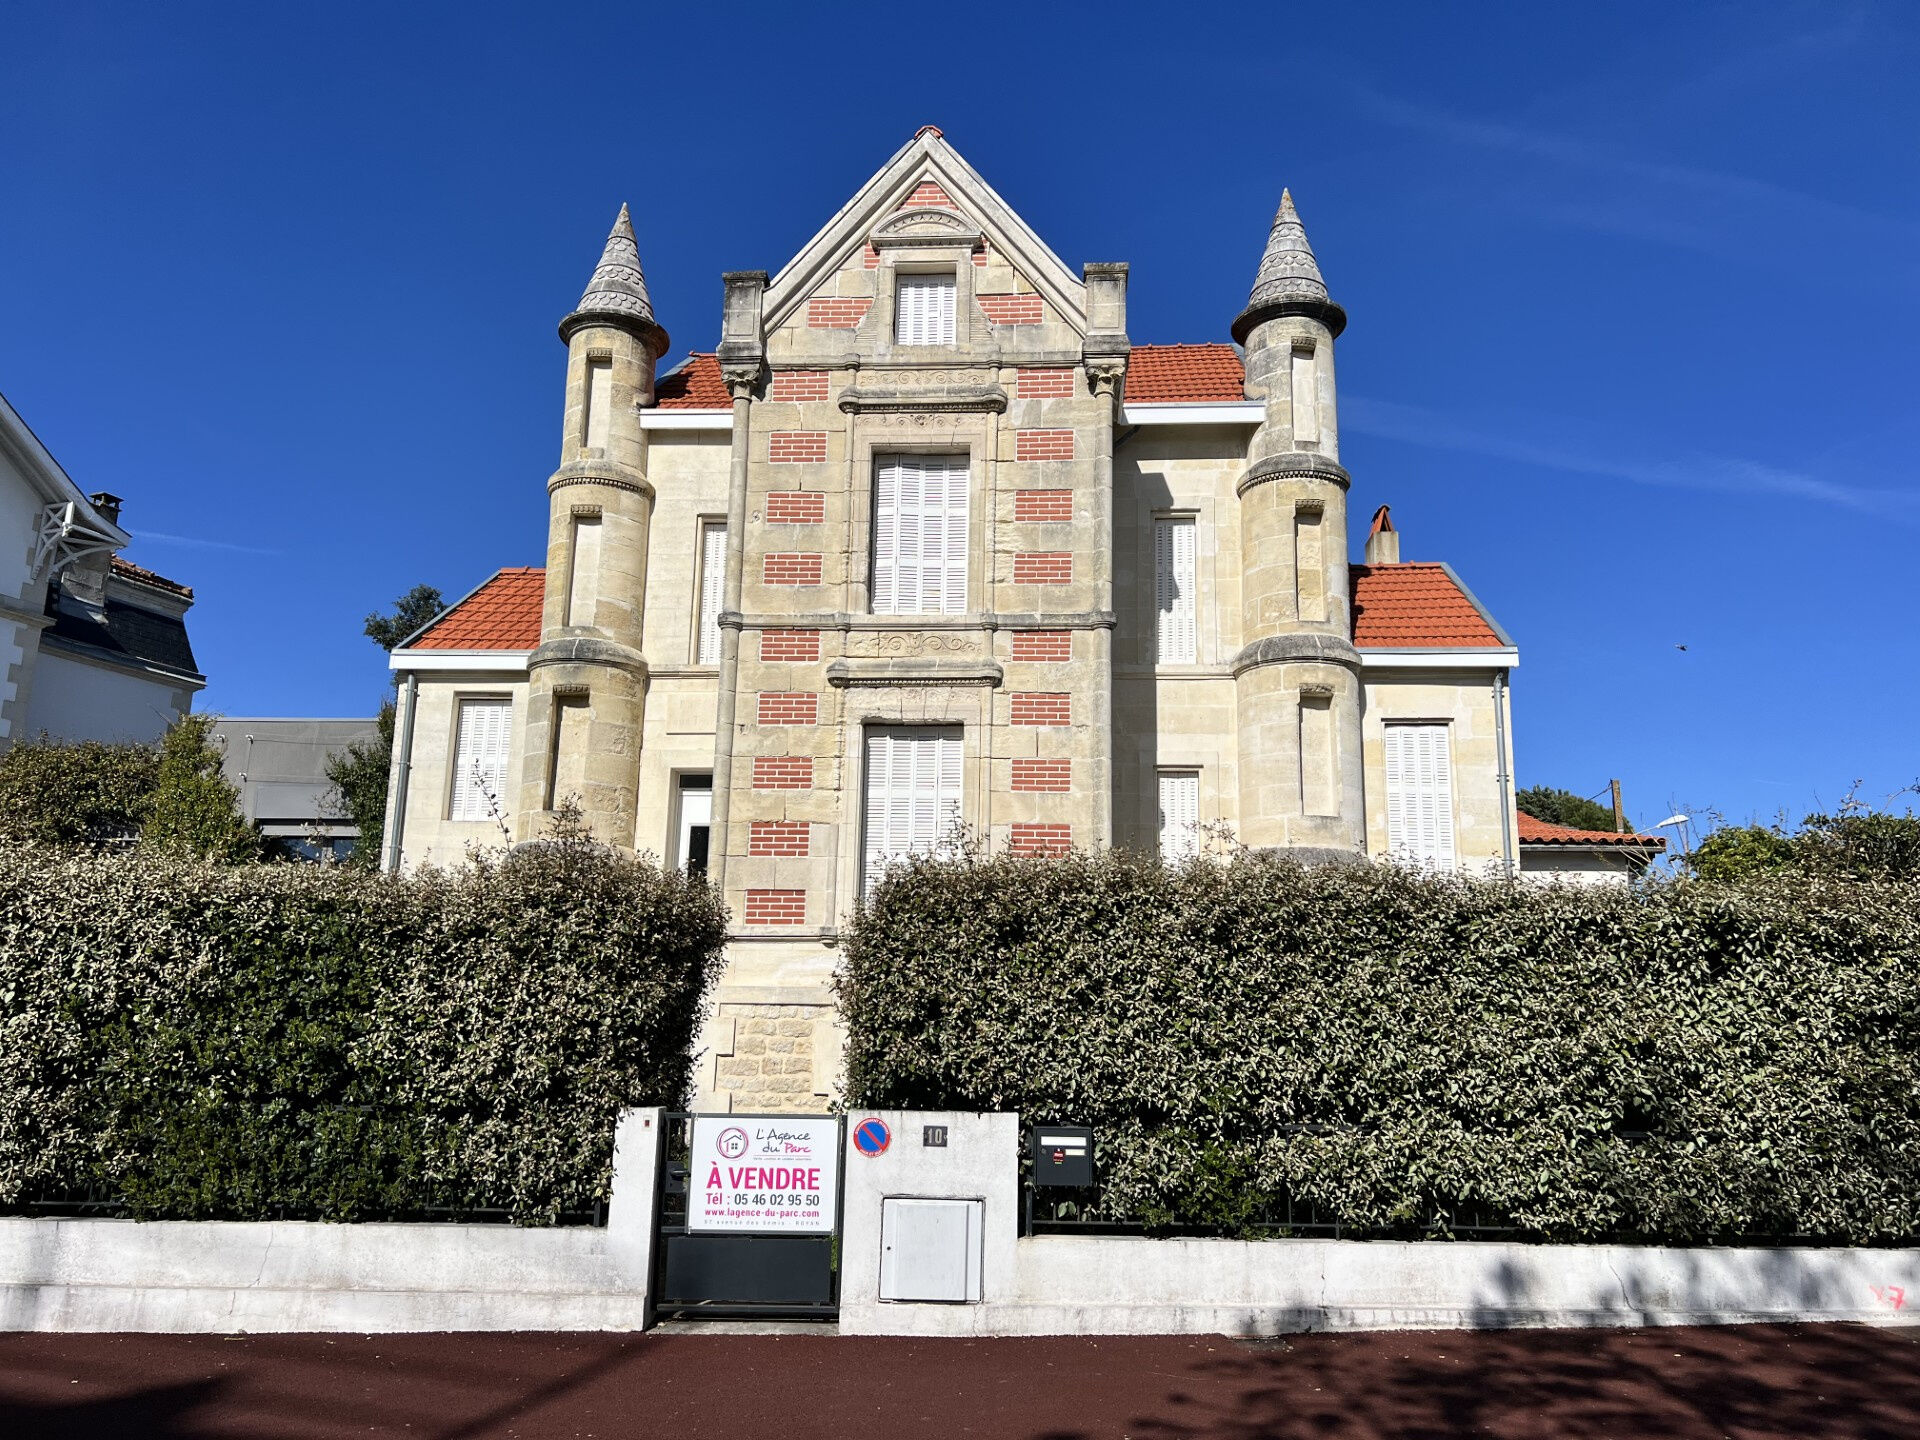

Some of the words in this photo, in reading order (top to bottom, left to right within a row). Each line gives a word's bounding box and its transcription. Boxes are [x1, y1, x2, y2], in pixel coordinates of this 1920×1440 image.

[756, 1128, 811, 1144] L'Agence
[928, 1128, 942, 1144] 10
[762, 1142, 780, 1152] du
[784, 1143, 811, 1153] Parc
[706, 1161, 722, 1189] À
[728, 1168, 820, 1190] VENDRE
[706, 1193, 722, 1204] Tél
[734, 1194, 747, 1205] 05
[752, 1194, 766, 1205] 46
[770, 1195, 783, 1205] 02
[788, 1195, 801, 1206] 95
[806, 1195, 819, 1206] 50
[705, 1208, 819, 1218] www.lagence-du-parc.com
